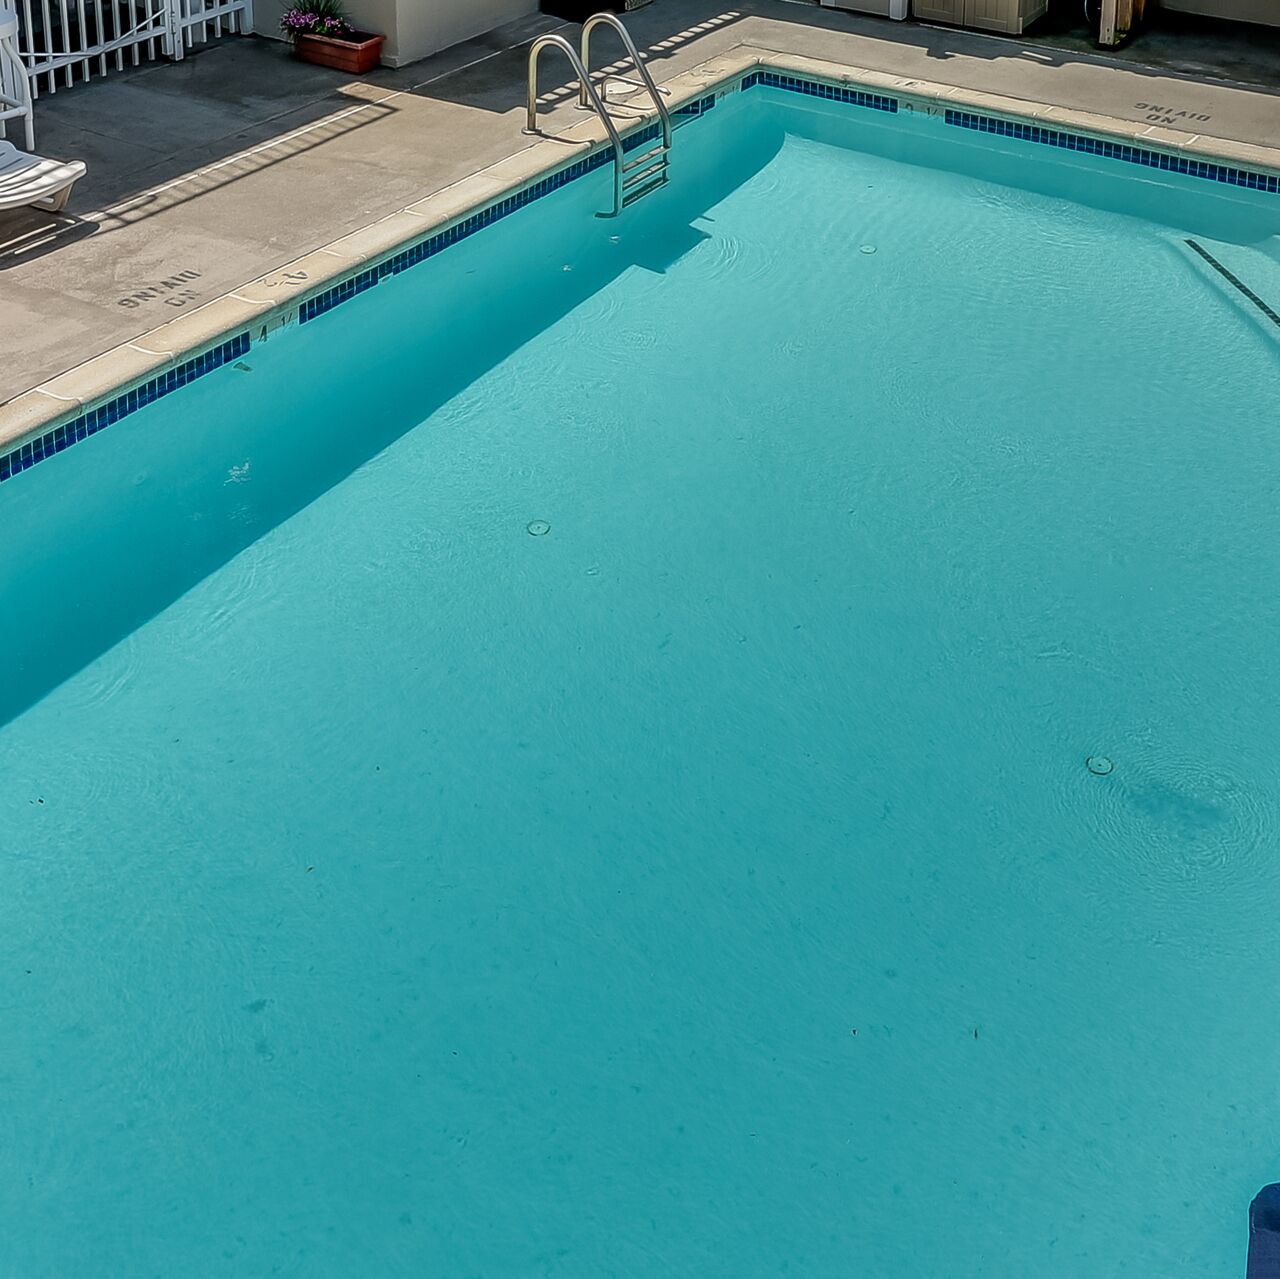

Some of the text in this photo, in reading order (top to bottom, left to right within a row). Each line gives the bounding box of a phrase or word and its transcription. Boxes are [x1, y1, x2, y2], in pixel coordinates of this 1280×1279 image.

[1134, 103, 1211, 122] DIVING
[1146, 114, 1176, 124] NO
[118, 270, 202, 309] DIVING
